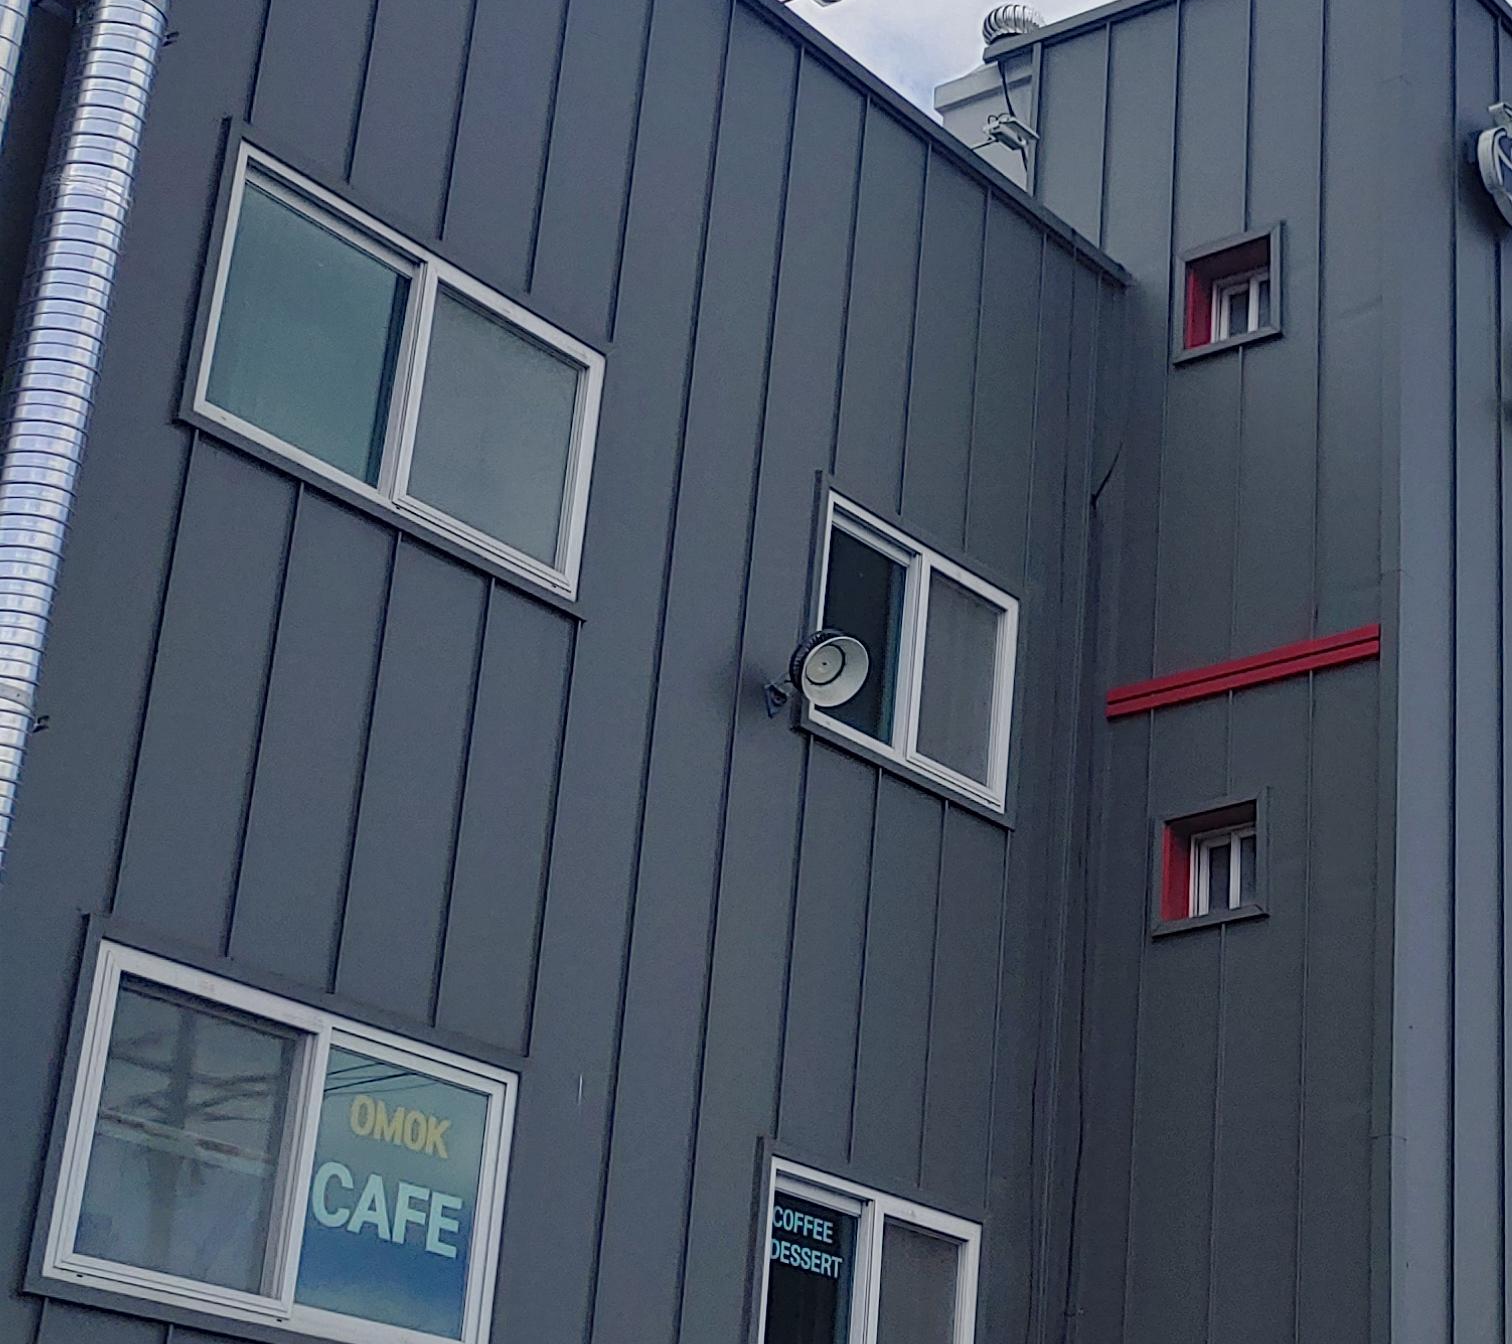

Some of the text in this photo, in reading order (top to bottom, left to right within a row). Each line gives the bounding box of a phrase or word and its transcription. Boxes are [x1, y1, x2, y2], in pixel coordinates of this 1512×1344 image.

[351, 1094, 450, 1159] OMOK
[312, 1161, 464, 1259] CAFE
[772, 1205, 834, 1244] COFFEE
[770, 1238, 843, 1278] DESSERT
